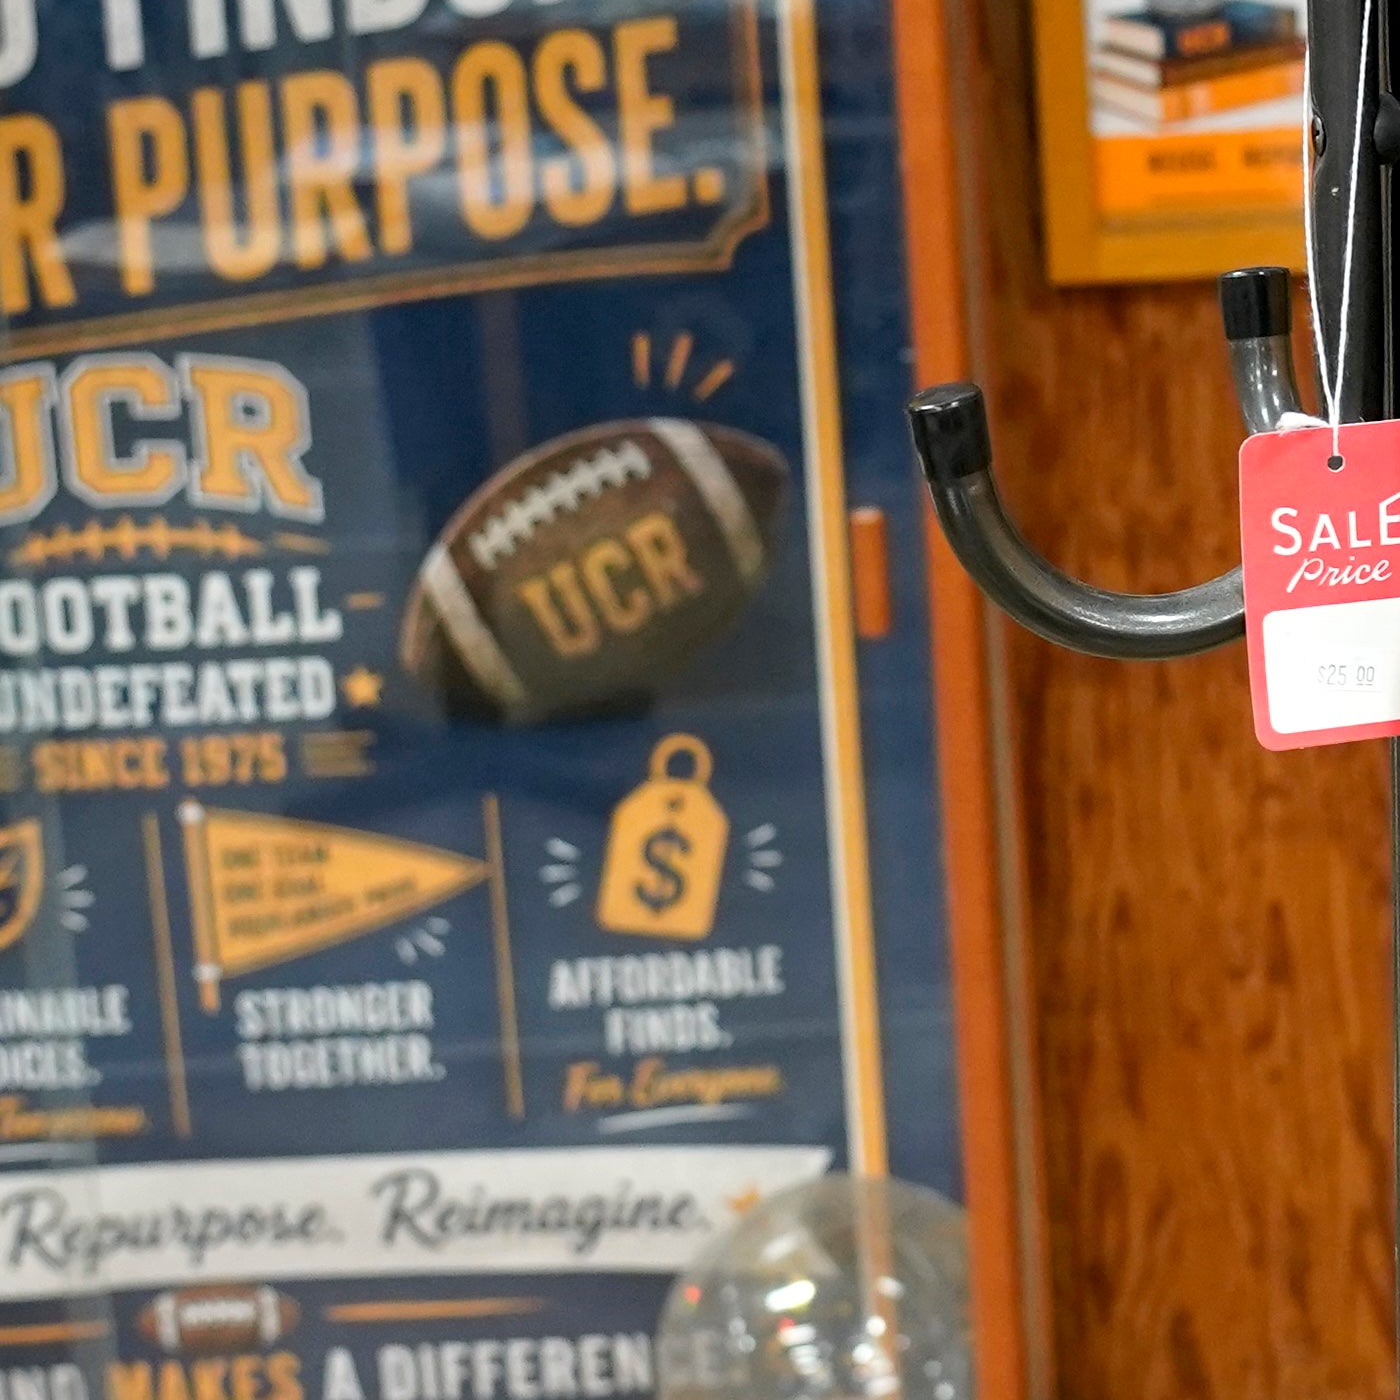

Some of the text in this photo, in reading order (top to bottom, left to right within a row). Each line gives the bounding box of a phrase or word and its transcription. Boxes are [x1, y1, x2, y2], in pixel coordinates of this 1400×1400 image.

[107, 16, 724, 297] PURPOSE.
[522, 511, 706, 660] UCR
[1286, 556, 1392, 593] Price
[33, 730, 289, 791] SINCE 1975
[548, 944, 785, 1011] AFFORDABLE
[235, 979, 434, 1040] STRONGER
[605, 1002, 735, 1056] FINDS.
[237, 1032, 446, 1091] TOGETHER.
[4, 1168, 713, 1277] Repurpose. Reimagine.
[105, 1350, 305, 1400] MAKES
[322, 1346, 365, 1400] A
